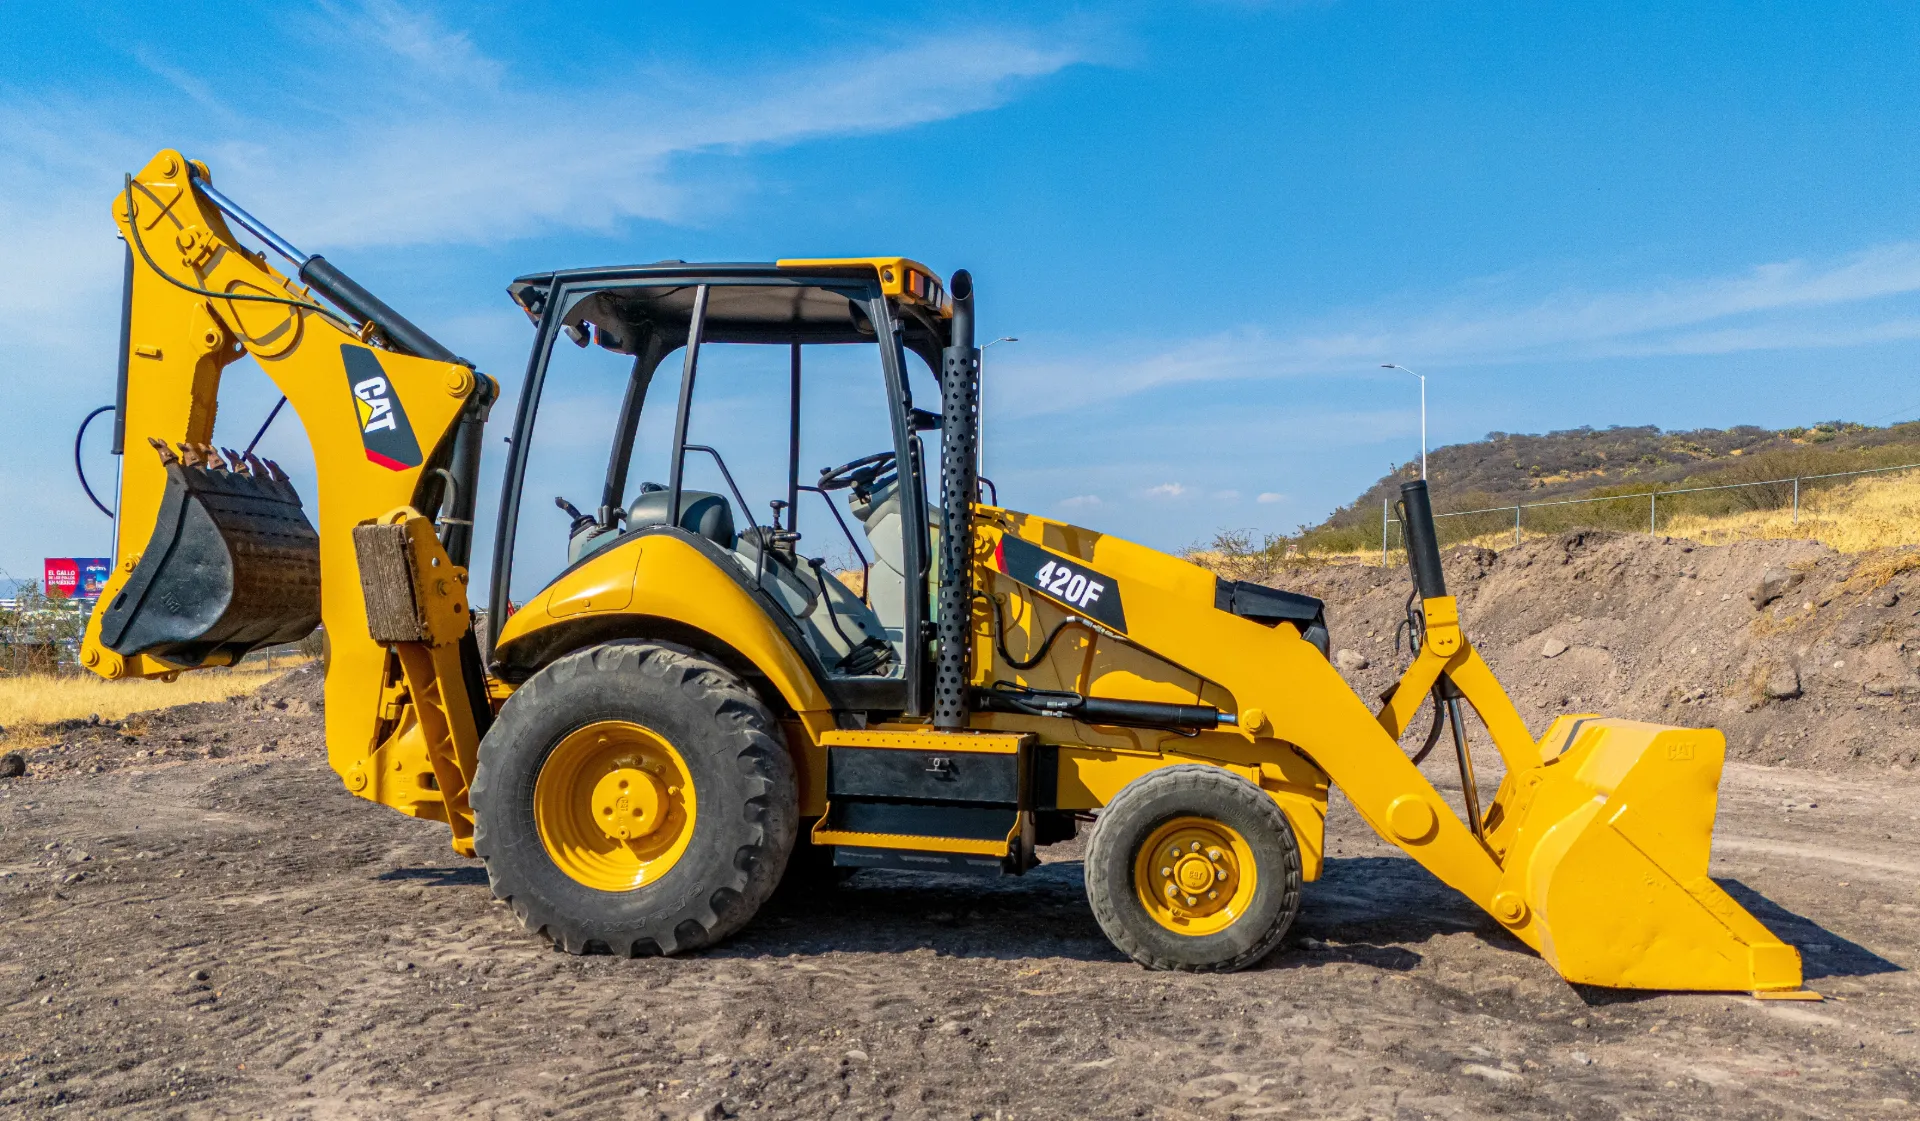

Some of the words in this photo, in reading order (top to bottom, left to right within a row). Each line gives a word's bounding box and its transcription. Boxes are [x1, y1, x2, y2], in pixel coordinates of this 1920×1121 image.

[354, 376, 397, 433] CAT
[1037, 560, 1105, 608] 420F
[1665, 742, 1697, 761] CAT
